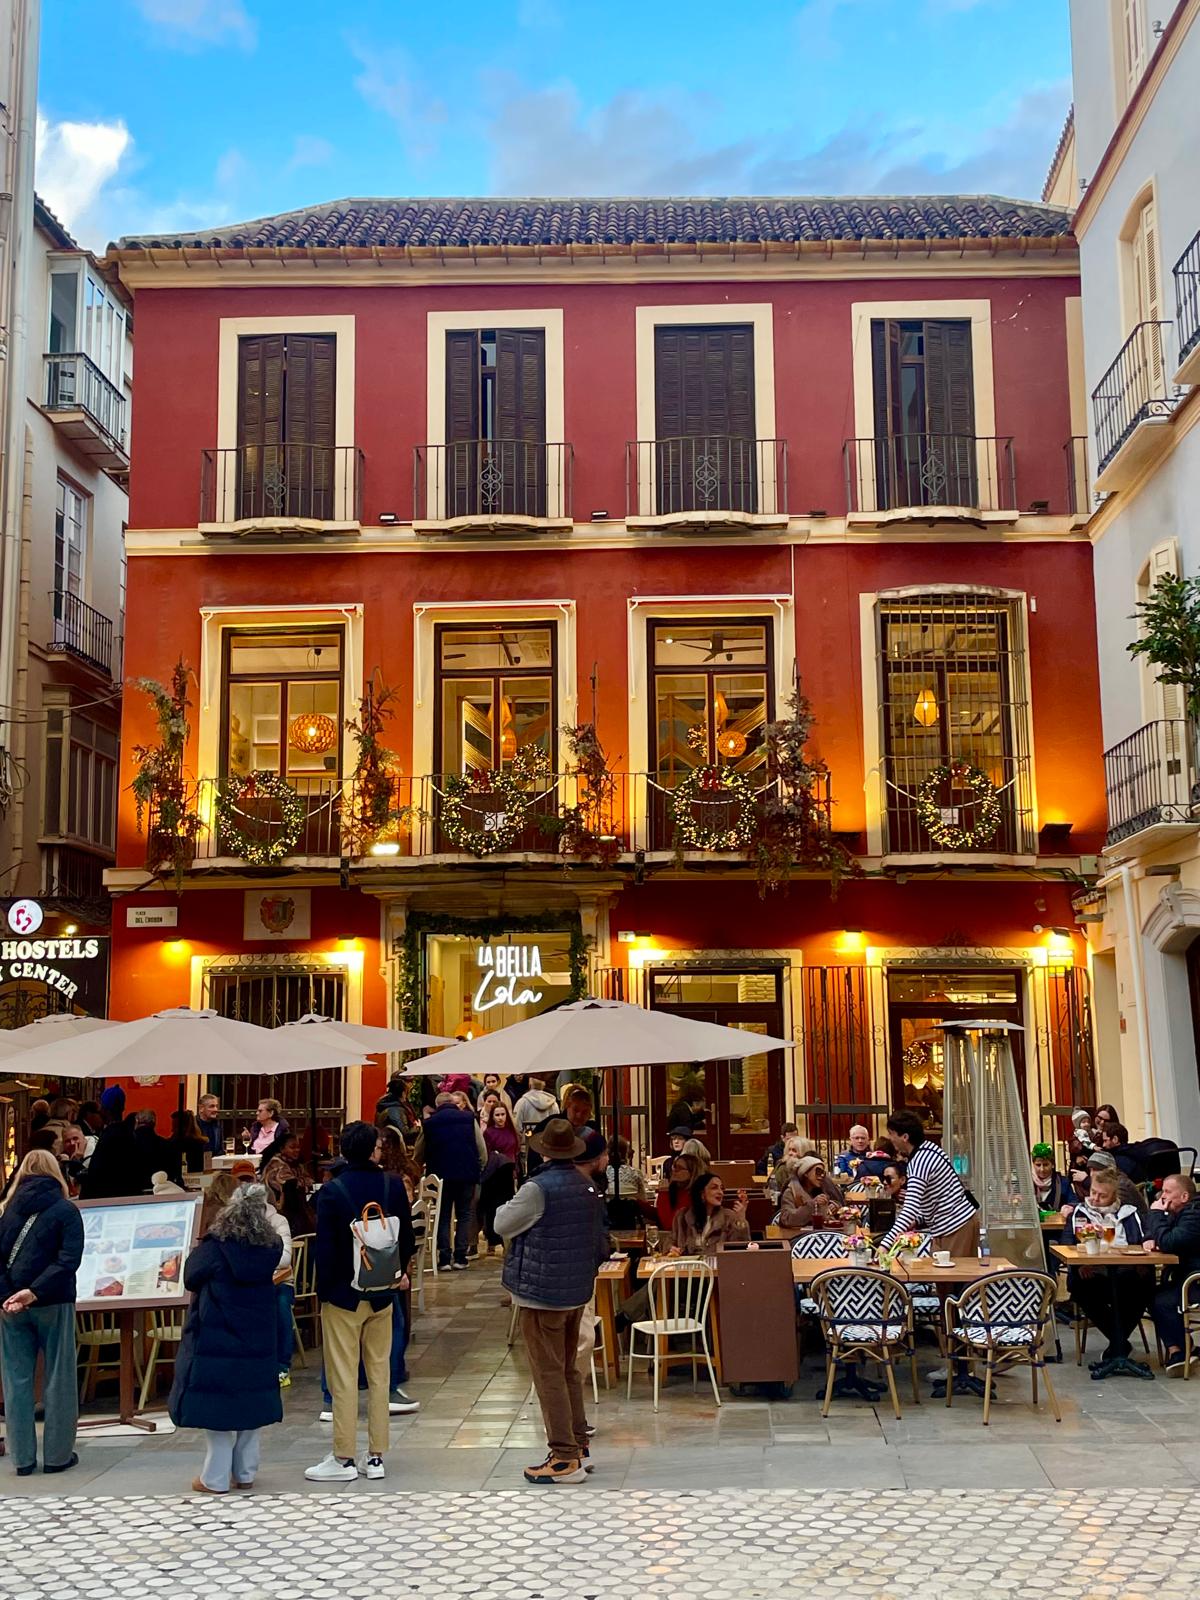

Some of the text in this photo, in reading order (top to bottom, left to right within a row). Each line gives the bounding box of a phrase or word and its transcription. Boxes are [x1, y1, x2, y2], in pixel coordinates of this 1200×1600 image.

[1, 939, 99, 960] HOSTELS
[478, 945, 542, 977] LA BELLA
[9, 962, 78, 999] CENTER
[473, 969, 543, 1012] Lola
